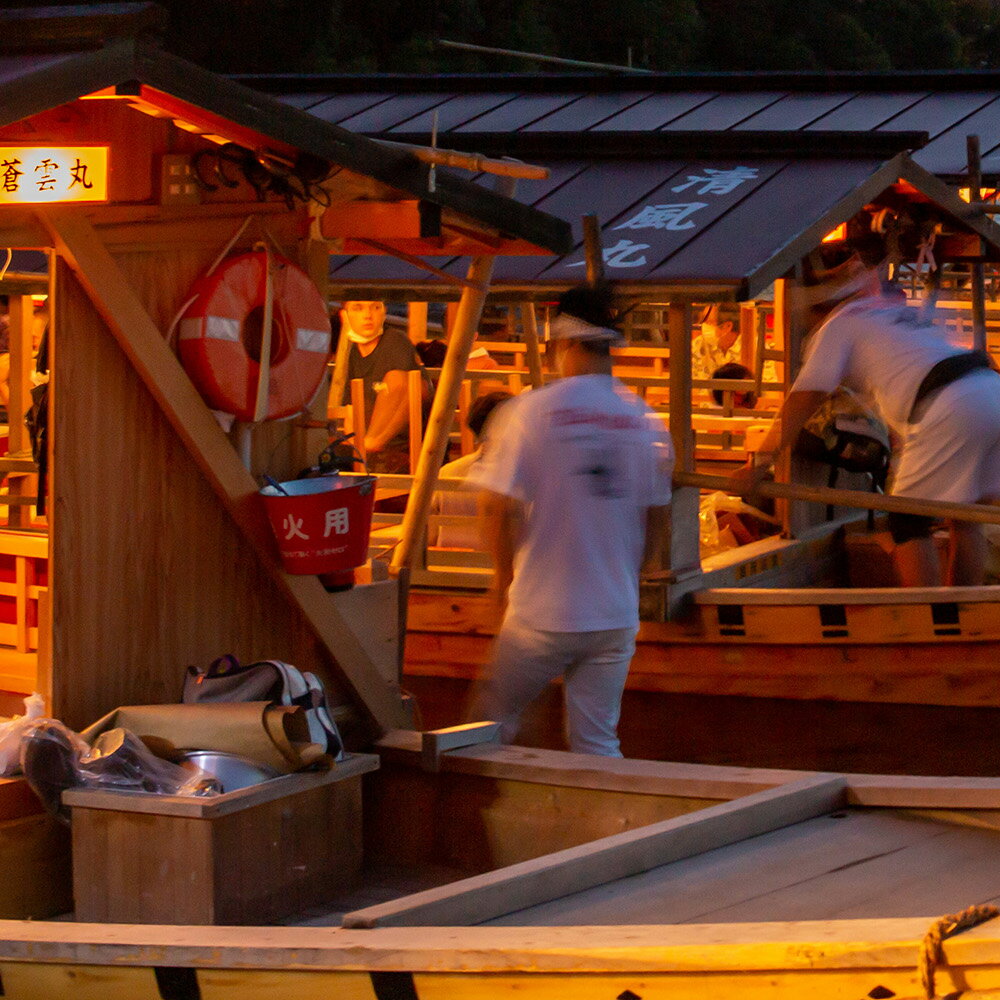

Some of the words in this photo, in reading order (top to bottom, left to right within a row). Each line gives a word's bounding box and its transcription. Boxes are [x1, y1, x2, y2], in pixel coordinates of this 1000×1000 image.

[0, 158, 93, 192] 蒼雲丸
[566, 165, 760, 268] 清風丸
[269, 507, 350, 540] 火用
